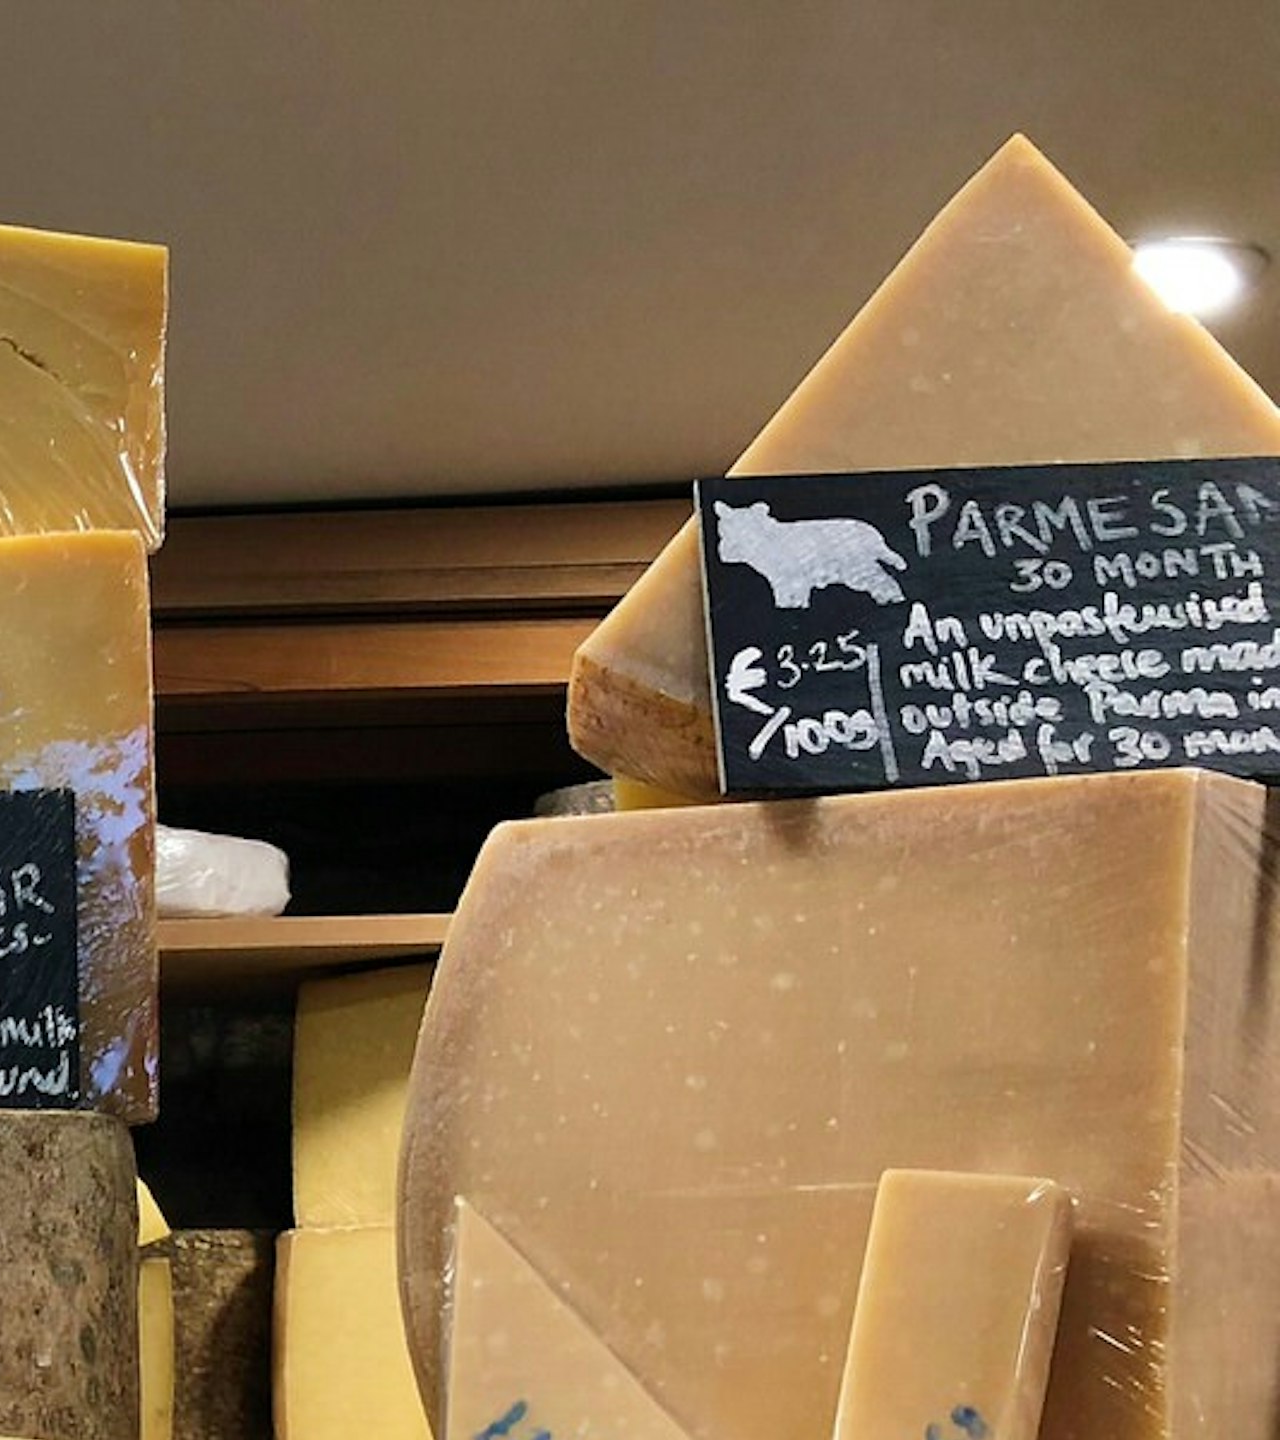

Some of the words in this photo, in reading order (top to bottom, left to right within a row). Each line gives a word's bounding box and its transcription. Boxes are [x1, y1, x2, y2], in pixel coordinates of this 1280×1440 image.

[1010, 558, 1073, 592] 30
[1094, 542, 1264, 589] MONTH
[904, 602, 969, 656] An
[899, 648, 1020, 692] milk
[1181, 628, 1280, 673] mad
[1108, 726, 1172, 767] 30
